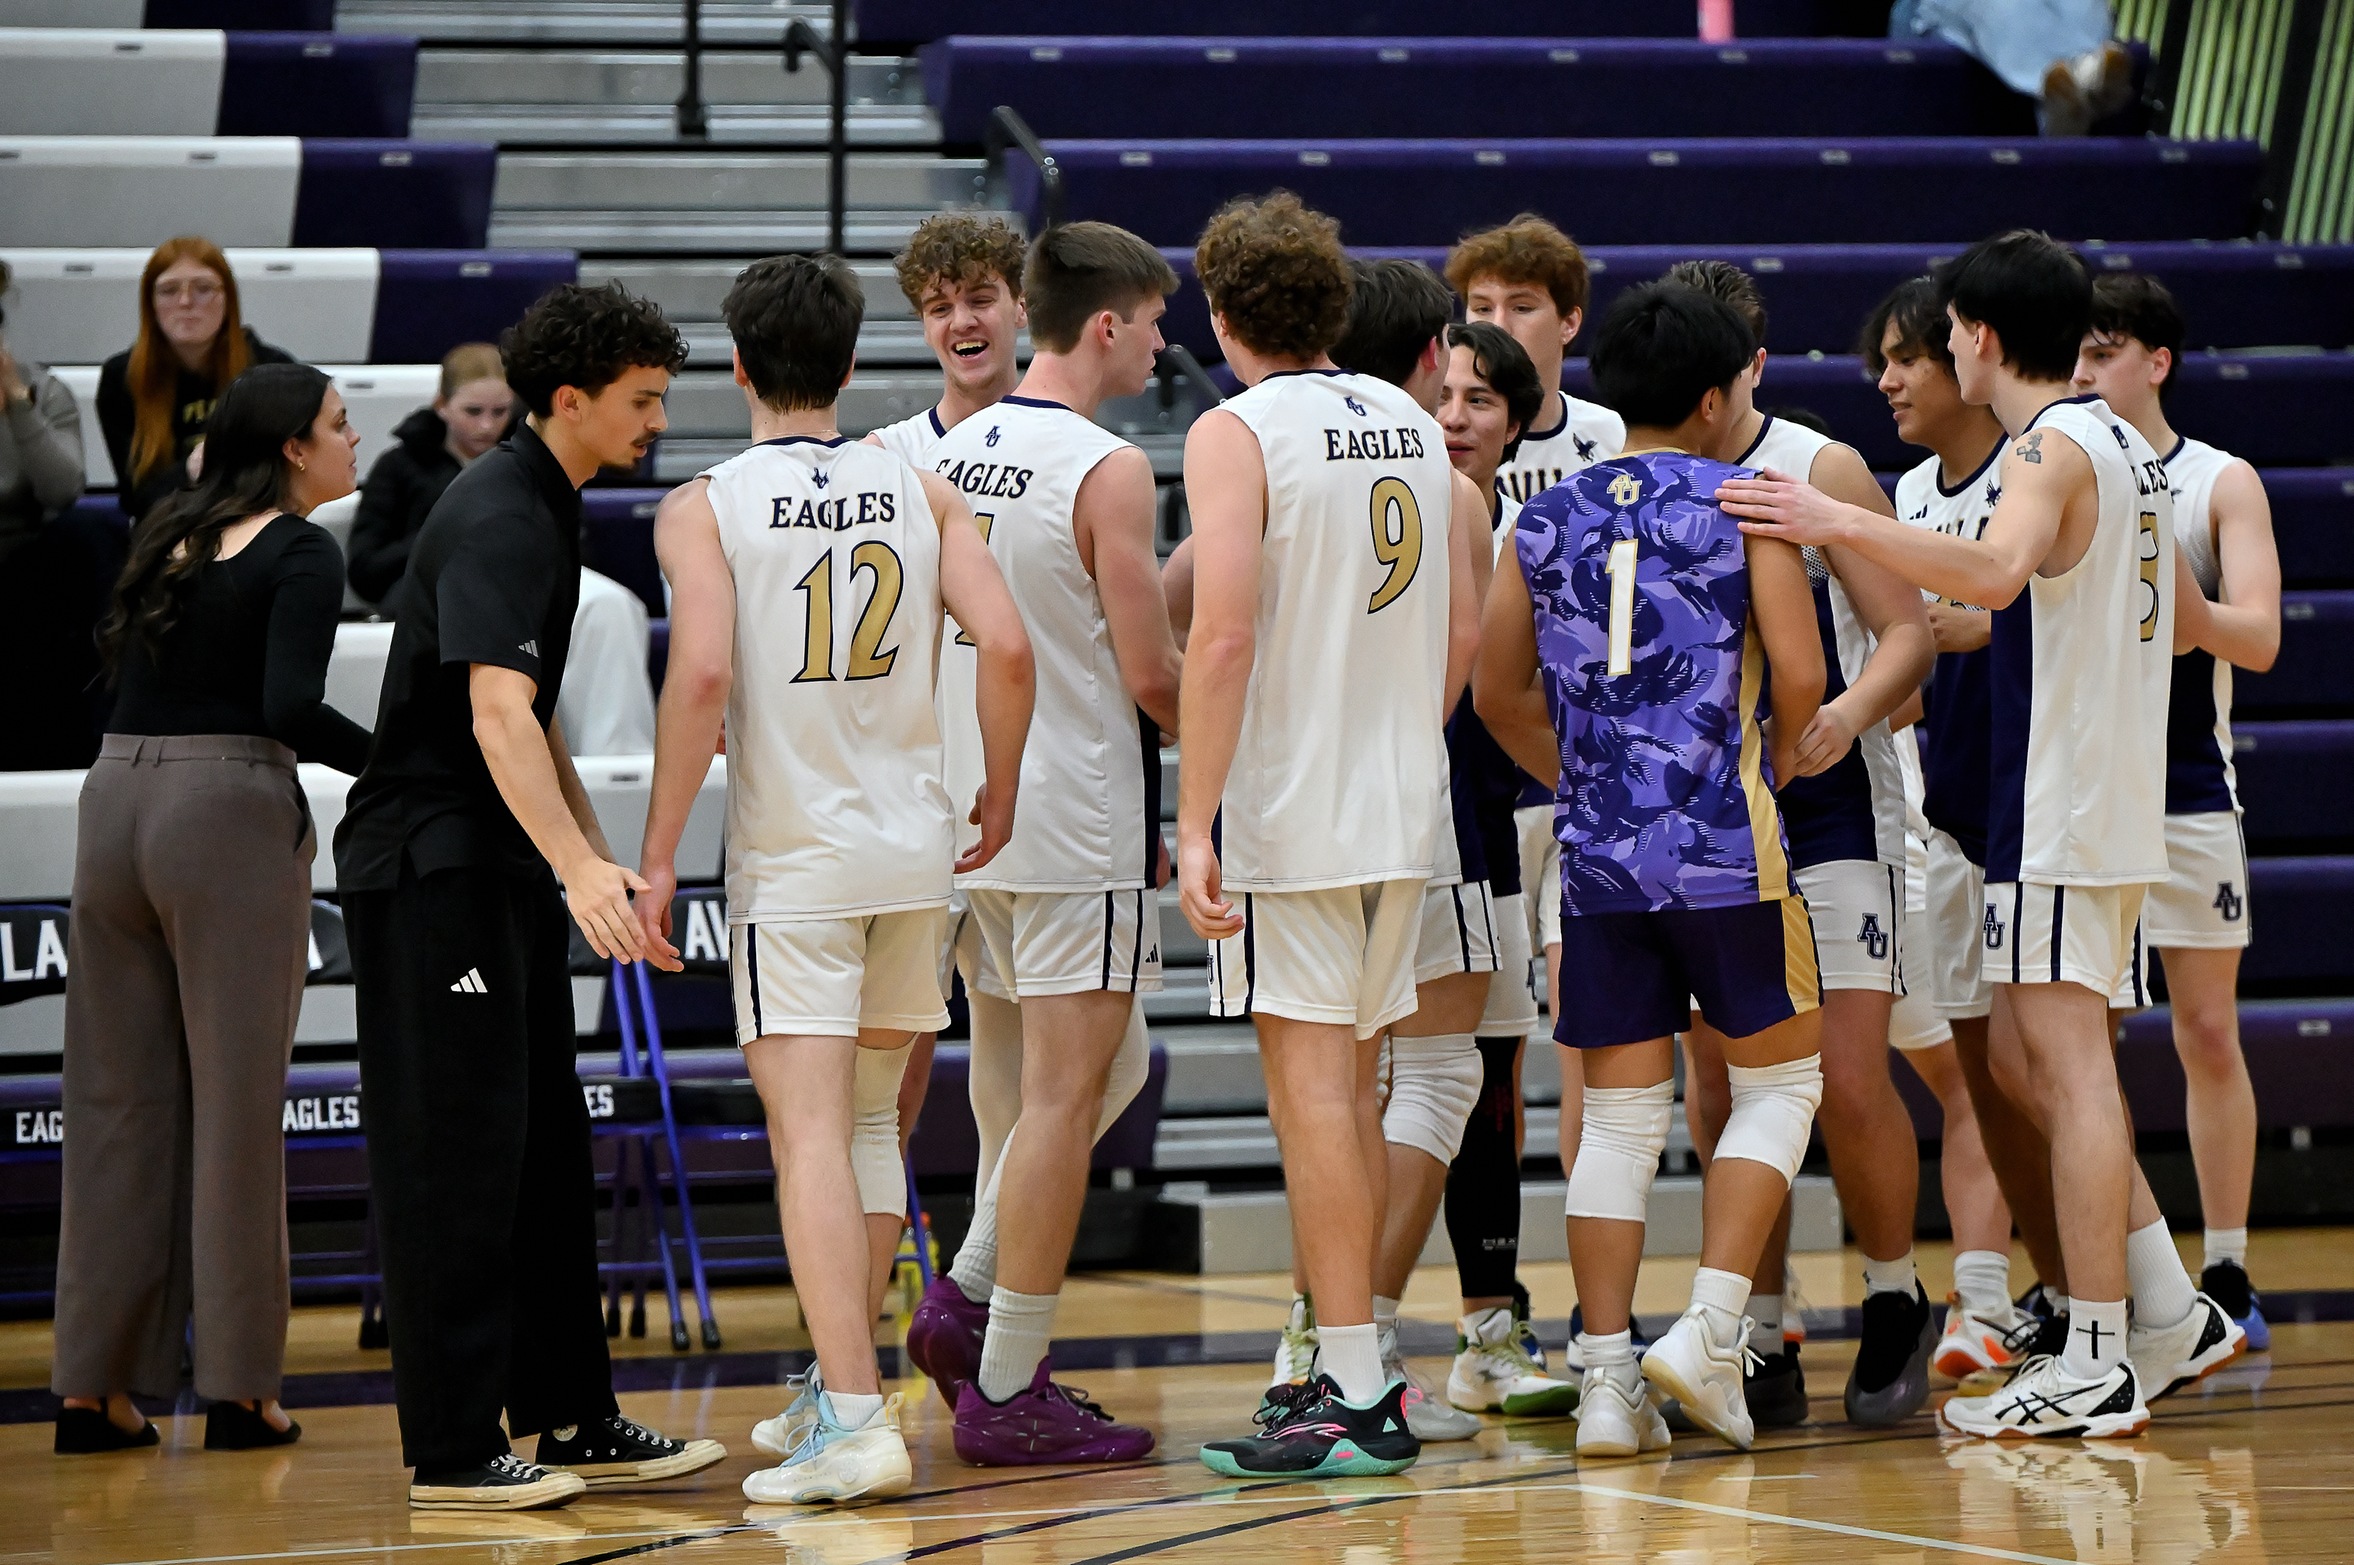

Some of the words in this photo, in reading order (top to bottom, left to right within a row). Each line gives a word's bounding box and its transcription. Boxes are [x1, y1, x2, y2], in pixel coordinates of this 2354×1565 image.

[1324, 427, 1425, 461] EAGLES
[769, 492, 896, 532] EAGLES
[1607, 474, 1642, 506] AU
[1367, 475, 1424, 614] 9
[788, 540, 904, 684] 12
[1605, 538, 1639, 676] 1
[685, 900, 729, 961] AV
[1857, 912, 1889, 961] AU
[16, 1111, 64, 1143] EAG
[282, 1096, 361, 1131] AGLES
